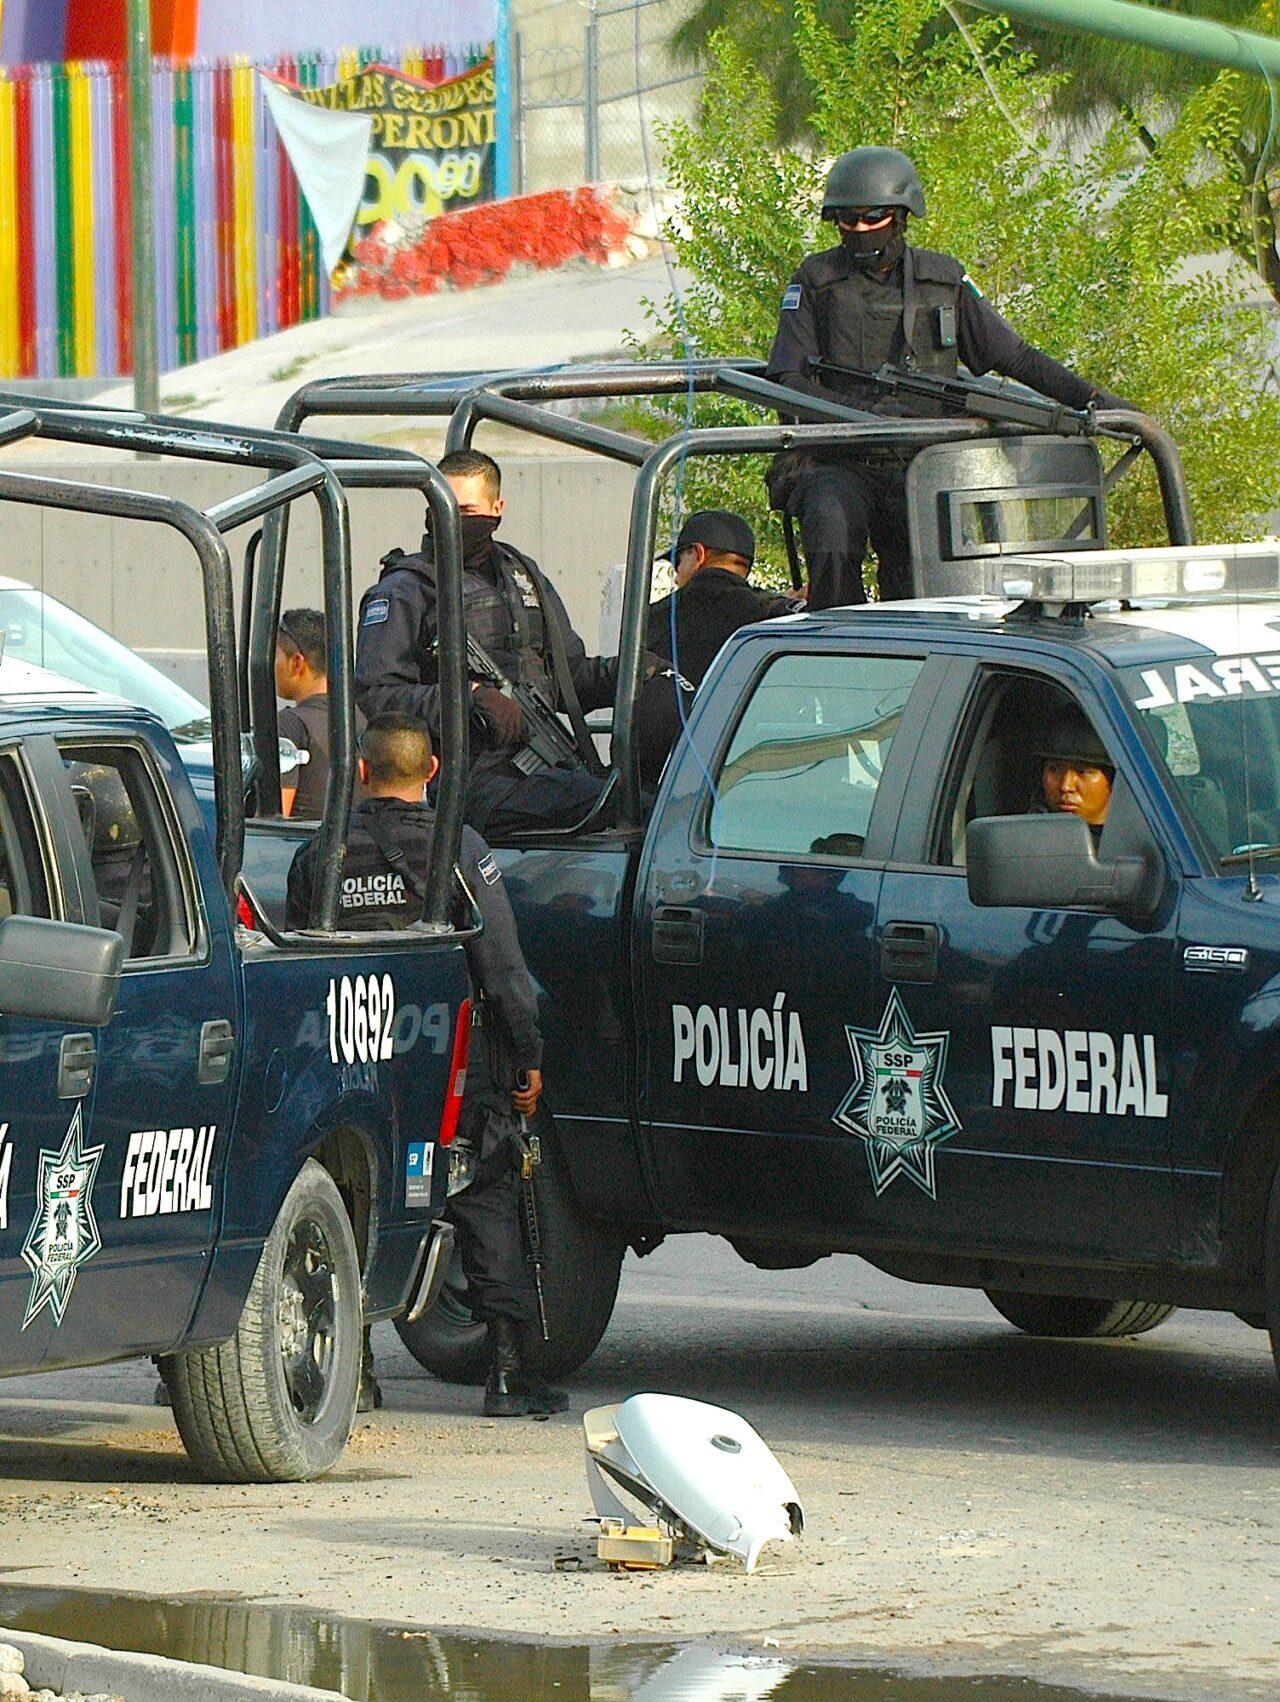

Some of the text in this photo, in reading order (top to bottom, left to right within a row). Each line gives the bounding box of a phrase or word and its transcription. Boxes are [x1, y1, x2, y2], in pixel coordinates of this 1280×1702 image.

[342, 873, 405, 894] OLICÍA
[340, 890, 407, 908] EDERAL
[326, 972, 396, 1065] 10692
[672, 992, 808, 1092] POLICÍA
[884, 1053, 913, 1067] SSP
[991, 1026, 1169, 1118] FEDERAL
[876, 1115, 917, 1127] POLICÍA
[876, 1125, 918, 1136] FEDERAL
[120, 1125, 217, 1219] FEDERAL
[56, 1173, 76, 1190] SSP
[46, 1252, 76, 1263] FEDERAL
